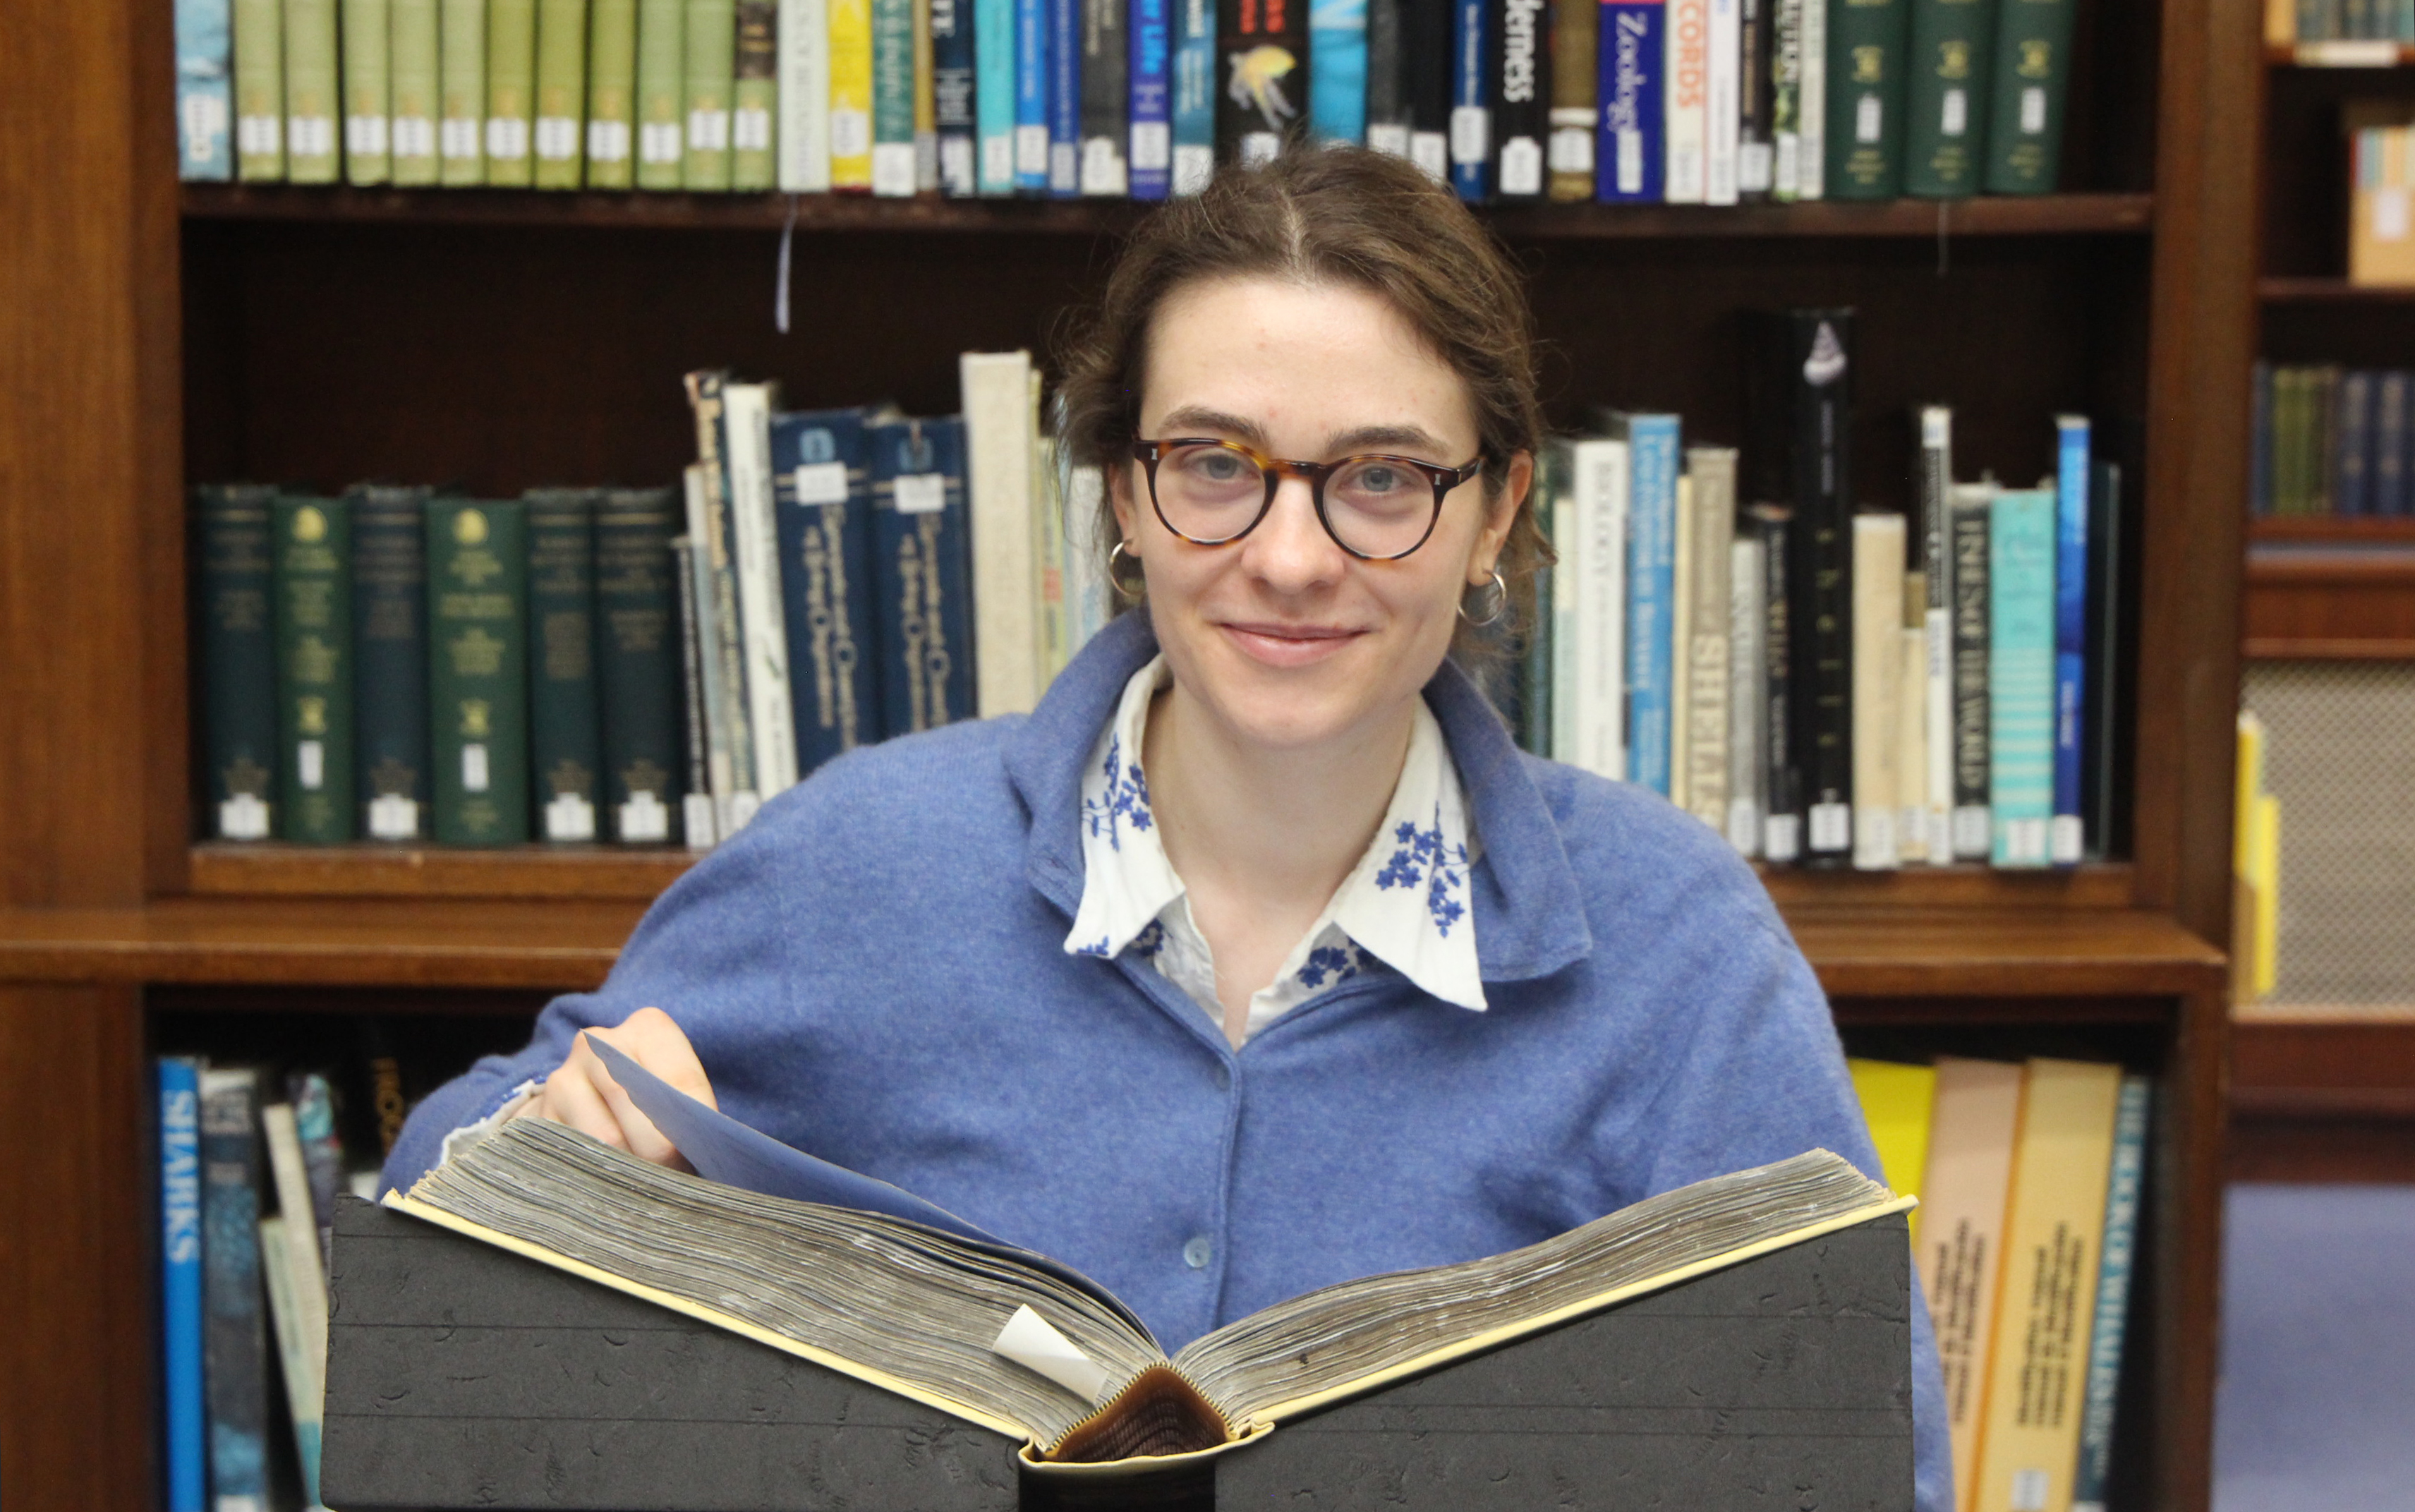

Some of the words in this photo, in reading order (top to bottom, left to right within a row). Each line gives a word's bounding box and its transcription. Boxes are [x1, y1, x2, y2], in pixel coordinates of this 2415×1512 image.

[1676, 2, 1704, 109] CORDS
[1691, 632, 1727, 830] SHELLS
[162, 1090, 198, 1264] SHARKS
